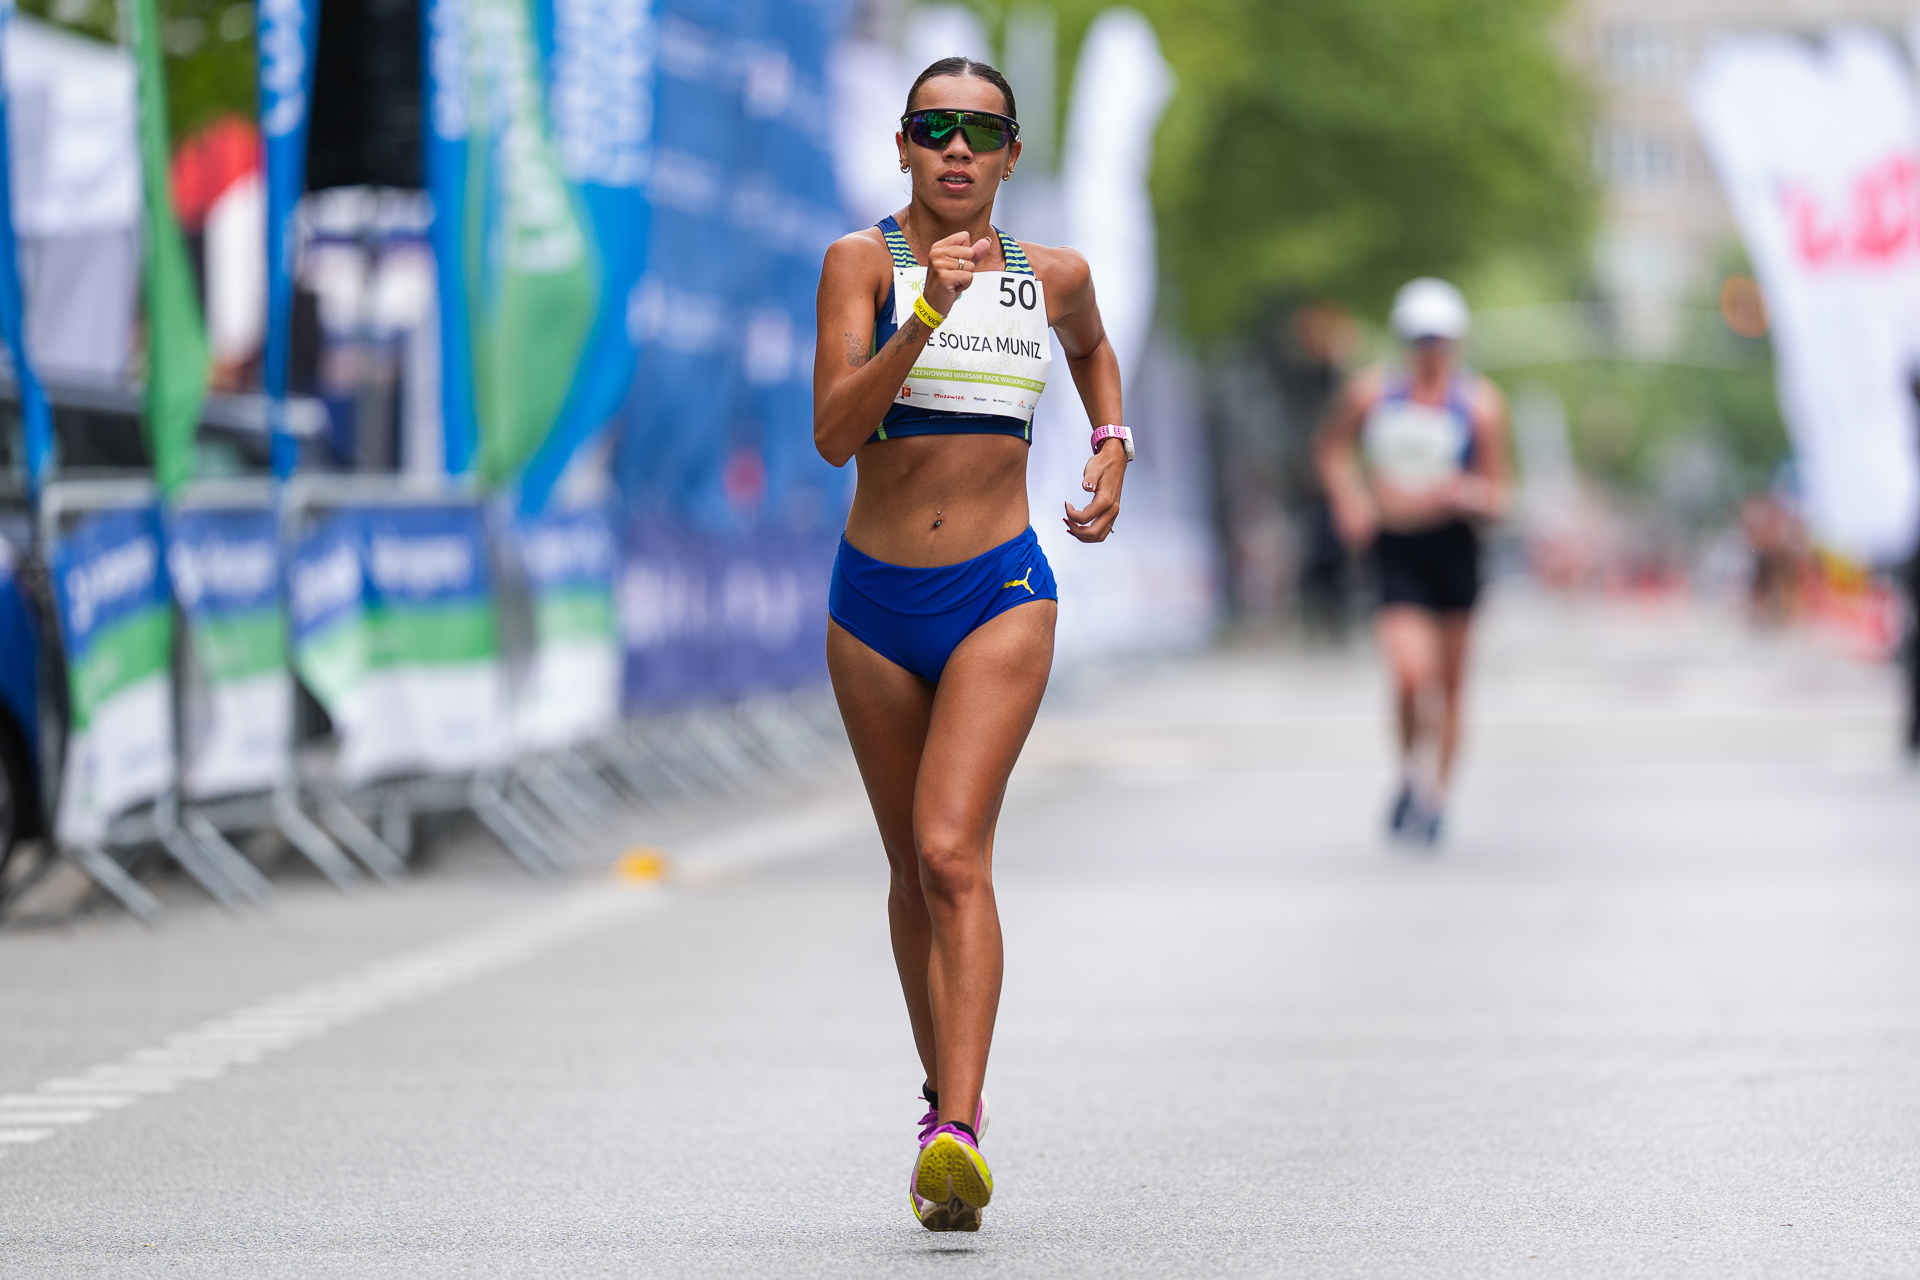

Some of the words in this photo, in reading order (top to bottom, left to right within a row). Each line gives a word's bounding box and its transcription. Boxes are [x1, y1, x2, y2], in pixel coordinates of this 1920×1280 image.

[999, 277, 1037, 310] 50
[926, 330, 935, 347] E
[939, 332, 993, 353] SOUZA
[996, 336, 1042, 360] MUNIZ
[953, 371, 984, 381] WARSAW
[983, 374, 1000, 384] RACE
[1000, 376, 1027, 388] WALKING
